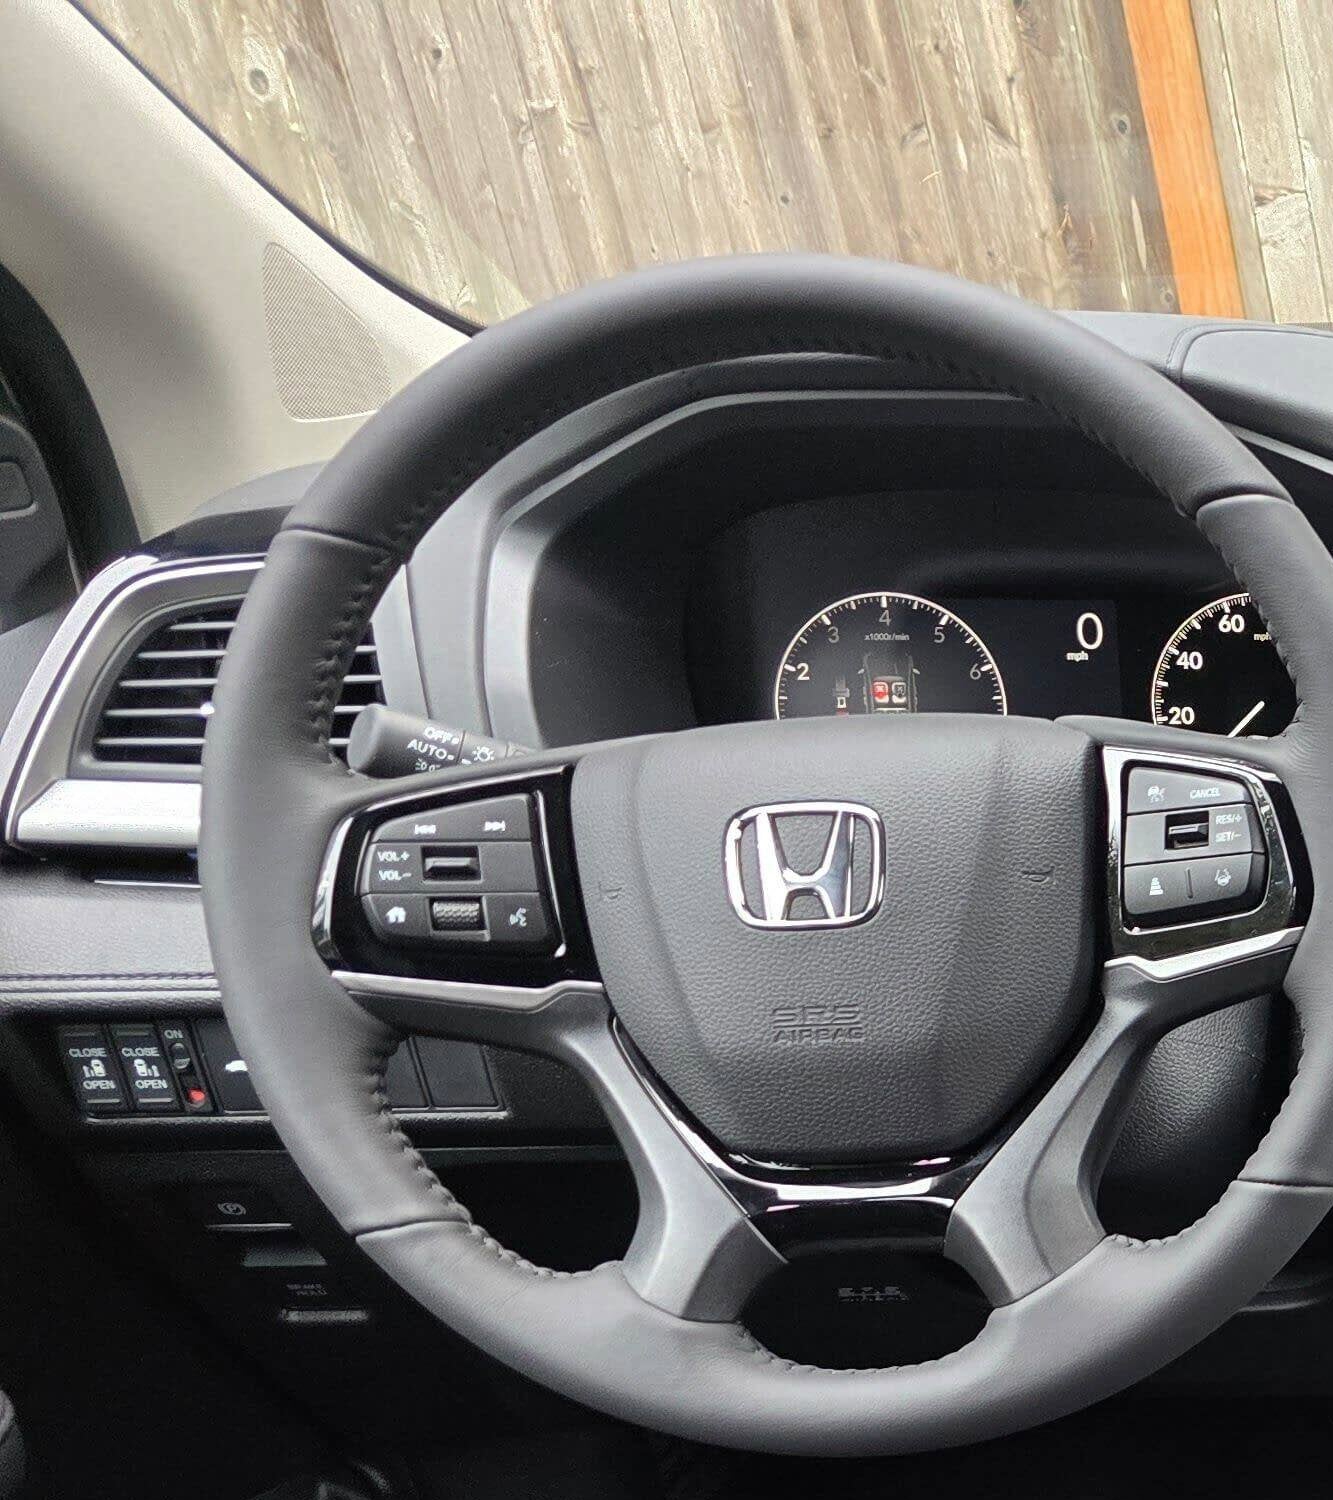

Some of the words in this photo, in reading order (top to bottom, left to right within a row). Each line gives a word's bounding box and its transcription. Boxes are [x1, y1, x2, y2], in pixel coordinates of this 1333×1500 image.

[878, 609, 892, 626] 4
[1218, 614, 1245, 632] 60
[827, 626, 840, 643] 3
[933, 626, 946, 643] 5
[1075, 612, 1104, 650] 0
[1066, 651, 1089, 662] mph
[1176, 651, 1203, 670] 40
[796, 662, 810, 681] 2
[969, 663, 982, 680] 6
[1168, 706, 1195, 725] 20
[424, 726, 452, 743] OFF
[407, 739, 448, 760] AUTO
[1189, 786, 1221, 800] CANCEL
[164, 1029, 184, 1039] ON
[68, 1048, 108, 1057] CLOSE
[121, 1047, 160, 1057] CLOSE
[83, 1080, 116, 1090] OPEN
[135, 1080, 168, 1089] OPEN
